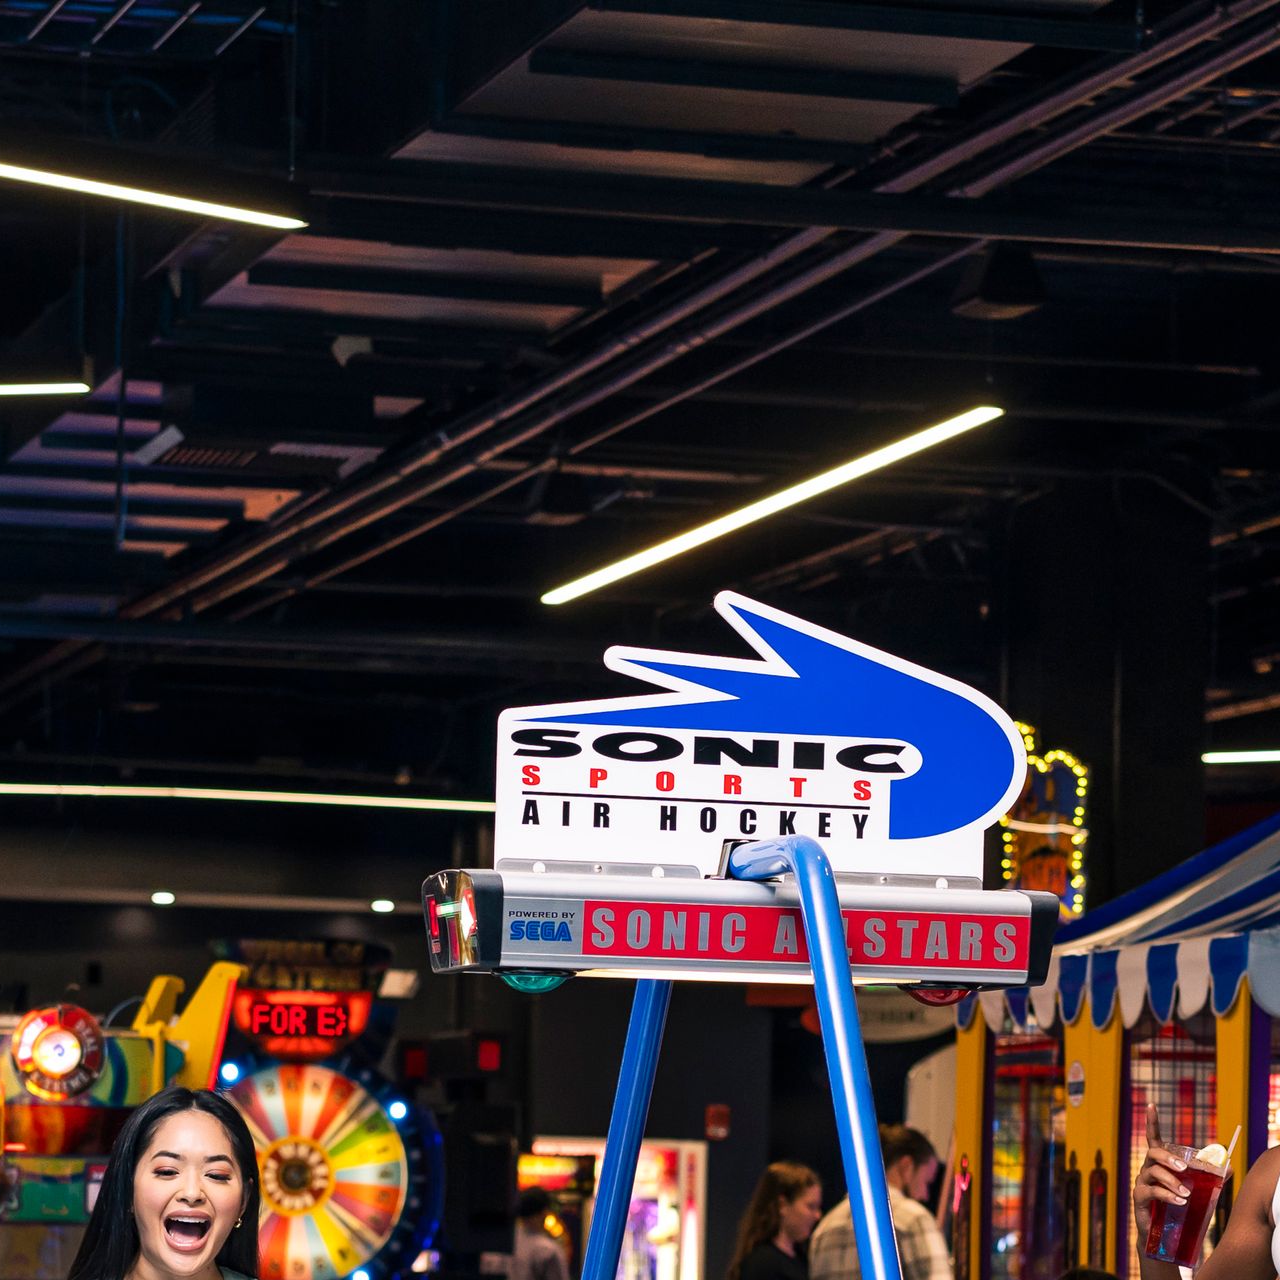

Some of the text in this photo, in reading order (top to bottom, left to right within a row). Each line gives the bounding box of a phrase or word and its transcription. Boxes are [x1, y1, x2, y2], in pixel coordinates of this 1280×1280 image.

[511, 728, 906, 774] SONIC
[521, 765, 872, 800] SPORTS
[521, 799, 869, 839] AIR HOCKEY
[508, 910, 576, 919] POWERED BY
[510, 919, 573, 942] SEGA
[591, 908, 1017, 962] SONIC ASTARS
[252, 1004, 307, 1035] FOR
